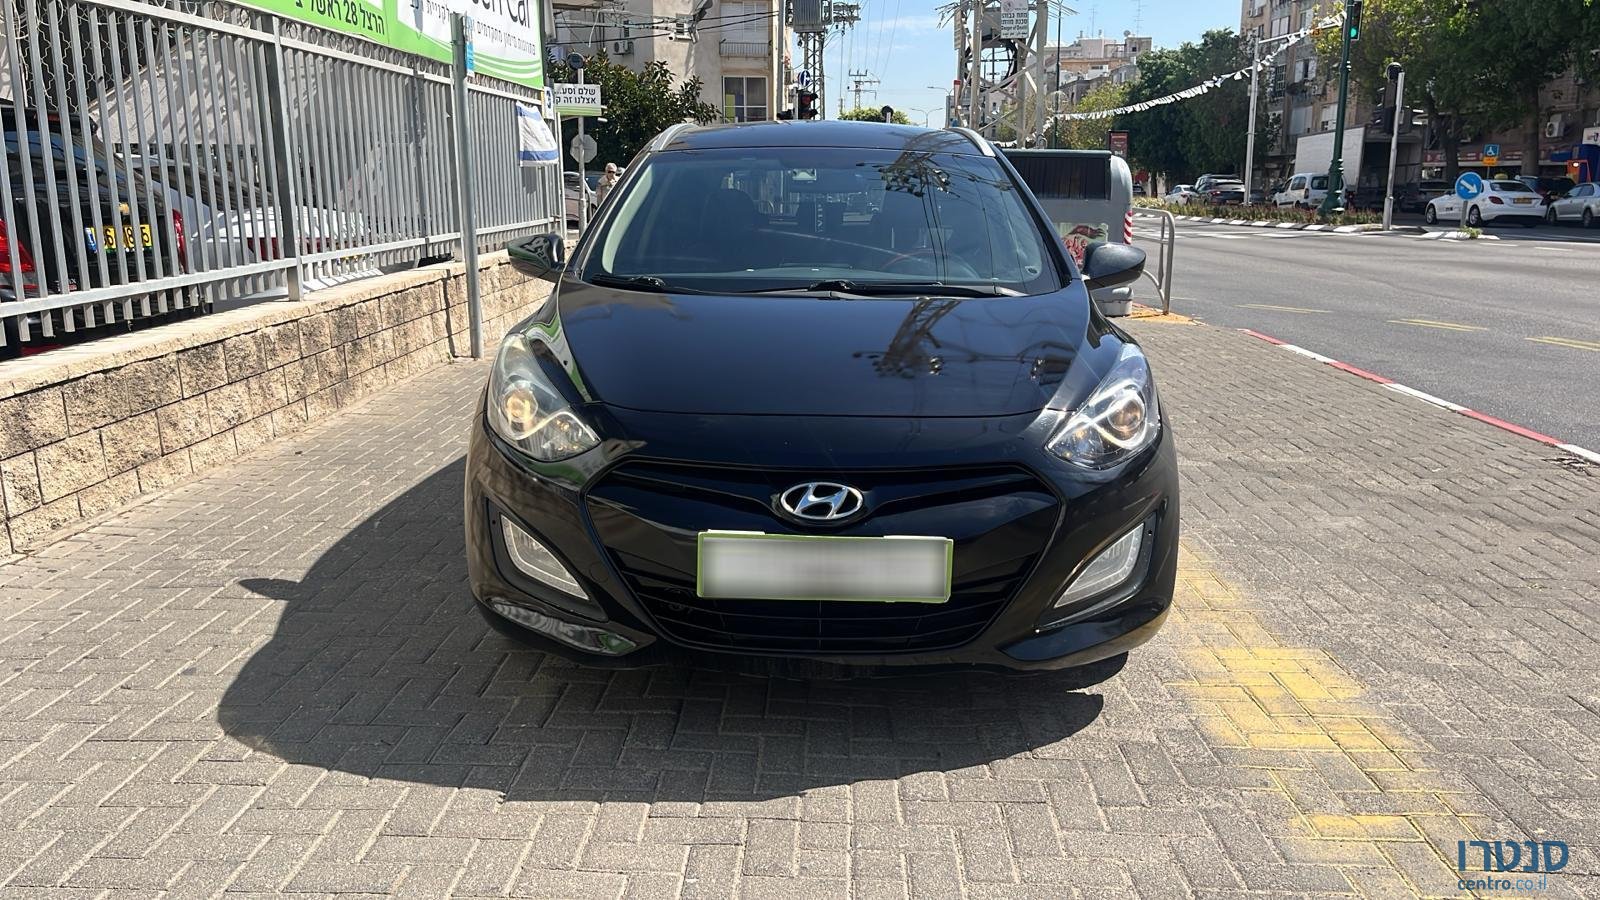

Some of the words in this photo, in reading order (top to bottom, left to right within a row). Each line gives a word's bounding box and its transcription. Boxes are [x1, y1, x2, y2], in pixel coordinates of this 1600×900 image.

[343, 0, 358, 25] 28
[359, 3, 385, 35] הרצל
[578, 87, 596, 95] שלם
[563, 96, 573, 104] זה
[575, 96, 596, 104] אצלנו
